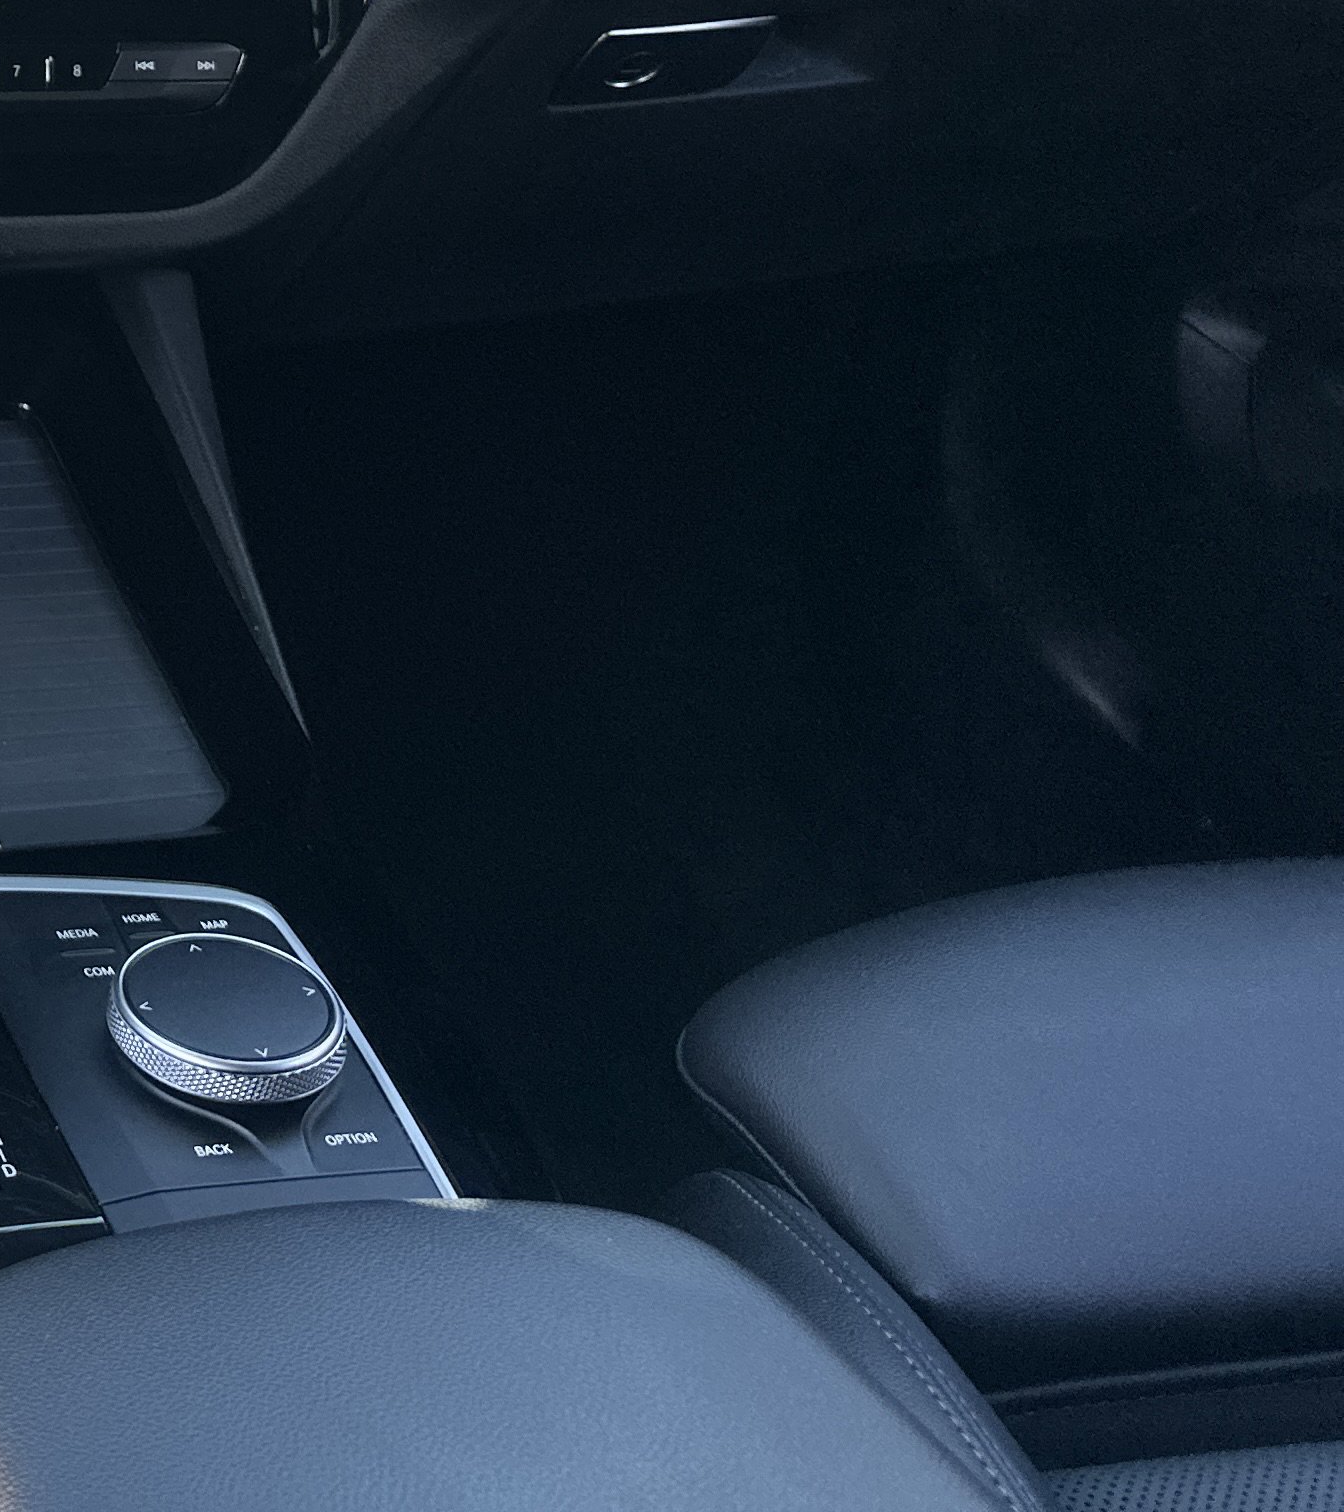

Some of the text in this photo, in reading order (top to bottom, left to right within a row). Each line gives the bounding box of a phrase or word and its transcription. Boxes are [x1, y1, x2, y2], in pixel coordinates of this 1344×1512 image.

[12, 64, 21, 78] 7
[73, 63, 83, 77] 8
[121, 912, 162, 924] HOME
[199, 919, 229, 930] MAP
[55, 927, 99, 940] MEDIA
[83, 965, 116, 978] COM
[324, 1131, 379, 1147] OPTION
[193, 1142, 235, 1158] BACK
[1, 1163, 18, 1178] D
